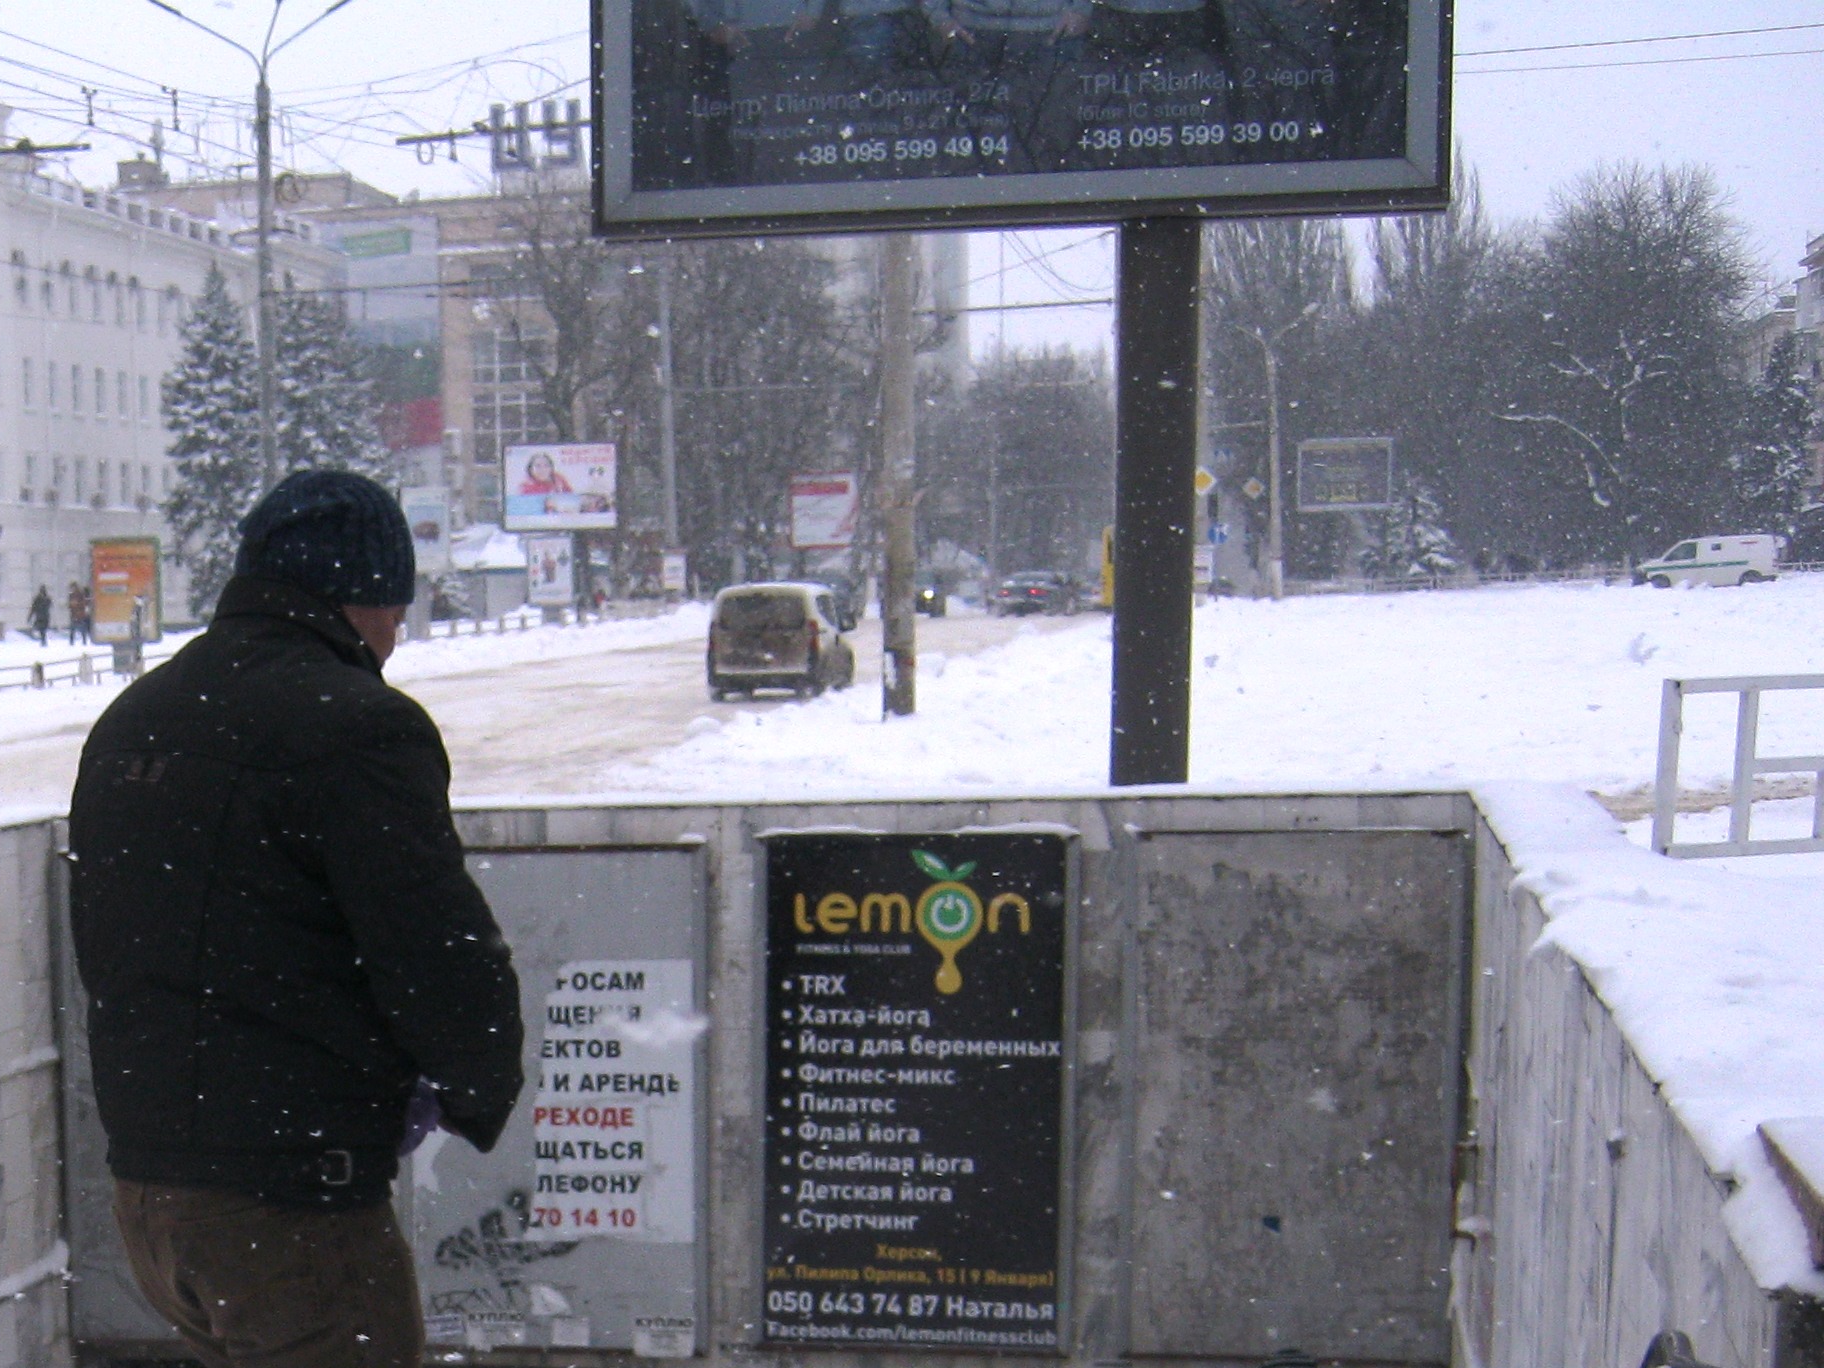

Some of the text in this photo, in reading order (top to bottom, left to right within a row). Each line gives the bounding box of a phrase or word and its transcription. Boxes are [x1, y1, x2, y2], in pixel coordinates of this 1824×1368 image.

[1079, 73, 1130, 96] ТРЦ
[1242, 67, 1257, 88] 2
[1266, 67, 1335, 90] черга
[1077, 120, 1300, 150] +38 095 599 39 00
[795, 135, 1009, 167] +38 095 599 49 94
[798, 974, 846, 996] TRX
[798, 1004, 931, 1027] Хатха-йога
[798, 1030, 1062, 1059] Йога для беременных
[798, 1061, 957, 1085] Фитнес-микс
[798, 1092, 897, 1114] Пилатес
[534, 1106, 635, 1129] РЕХОДЕ
[798, 1121, 921, 1144] Флай йога
[535, 1141, 644, 1162] ЩАТЬСЯ
[798, 1150, 975, 1174] Семейная йога
[536, 1174, 642, 1194] ЛЕФОНУ
[797, 1179, 953, 1203] Детская йога
[533, 1207, 636, 1228] 70 14 10
[797, 1208, 920, 1234] Стретчинг
[767, 1290, 1056, 1321] 050 643 74 87 Наталья
